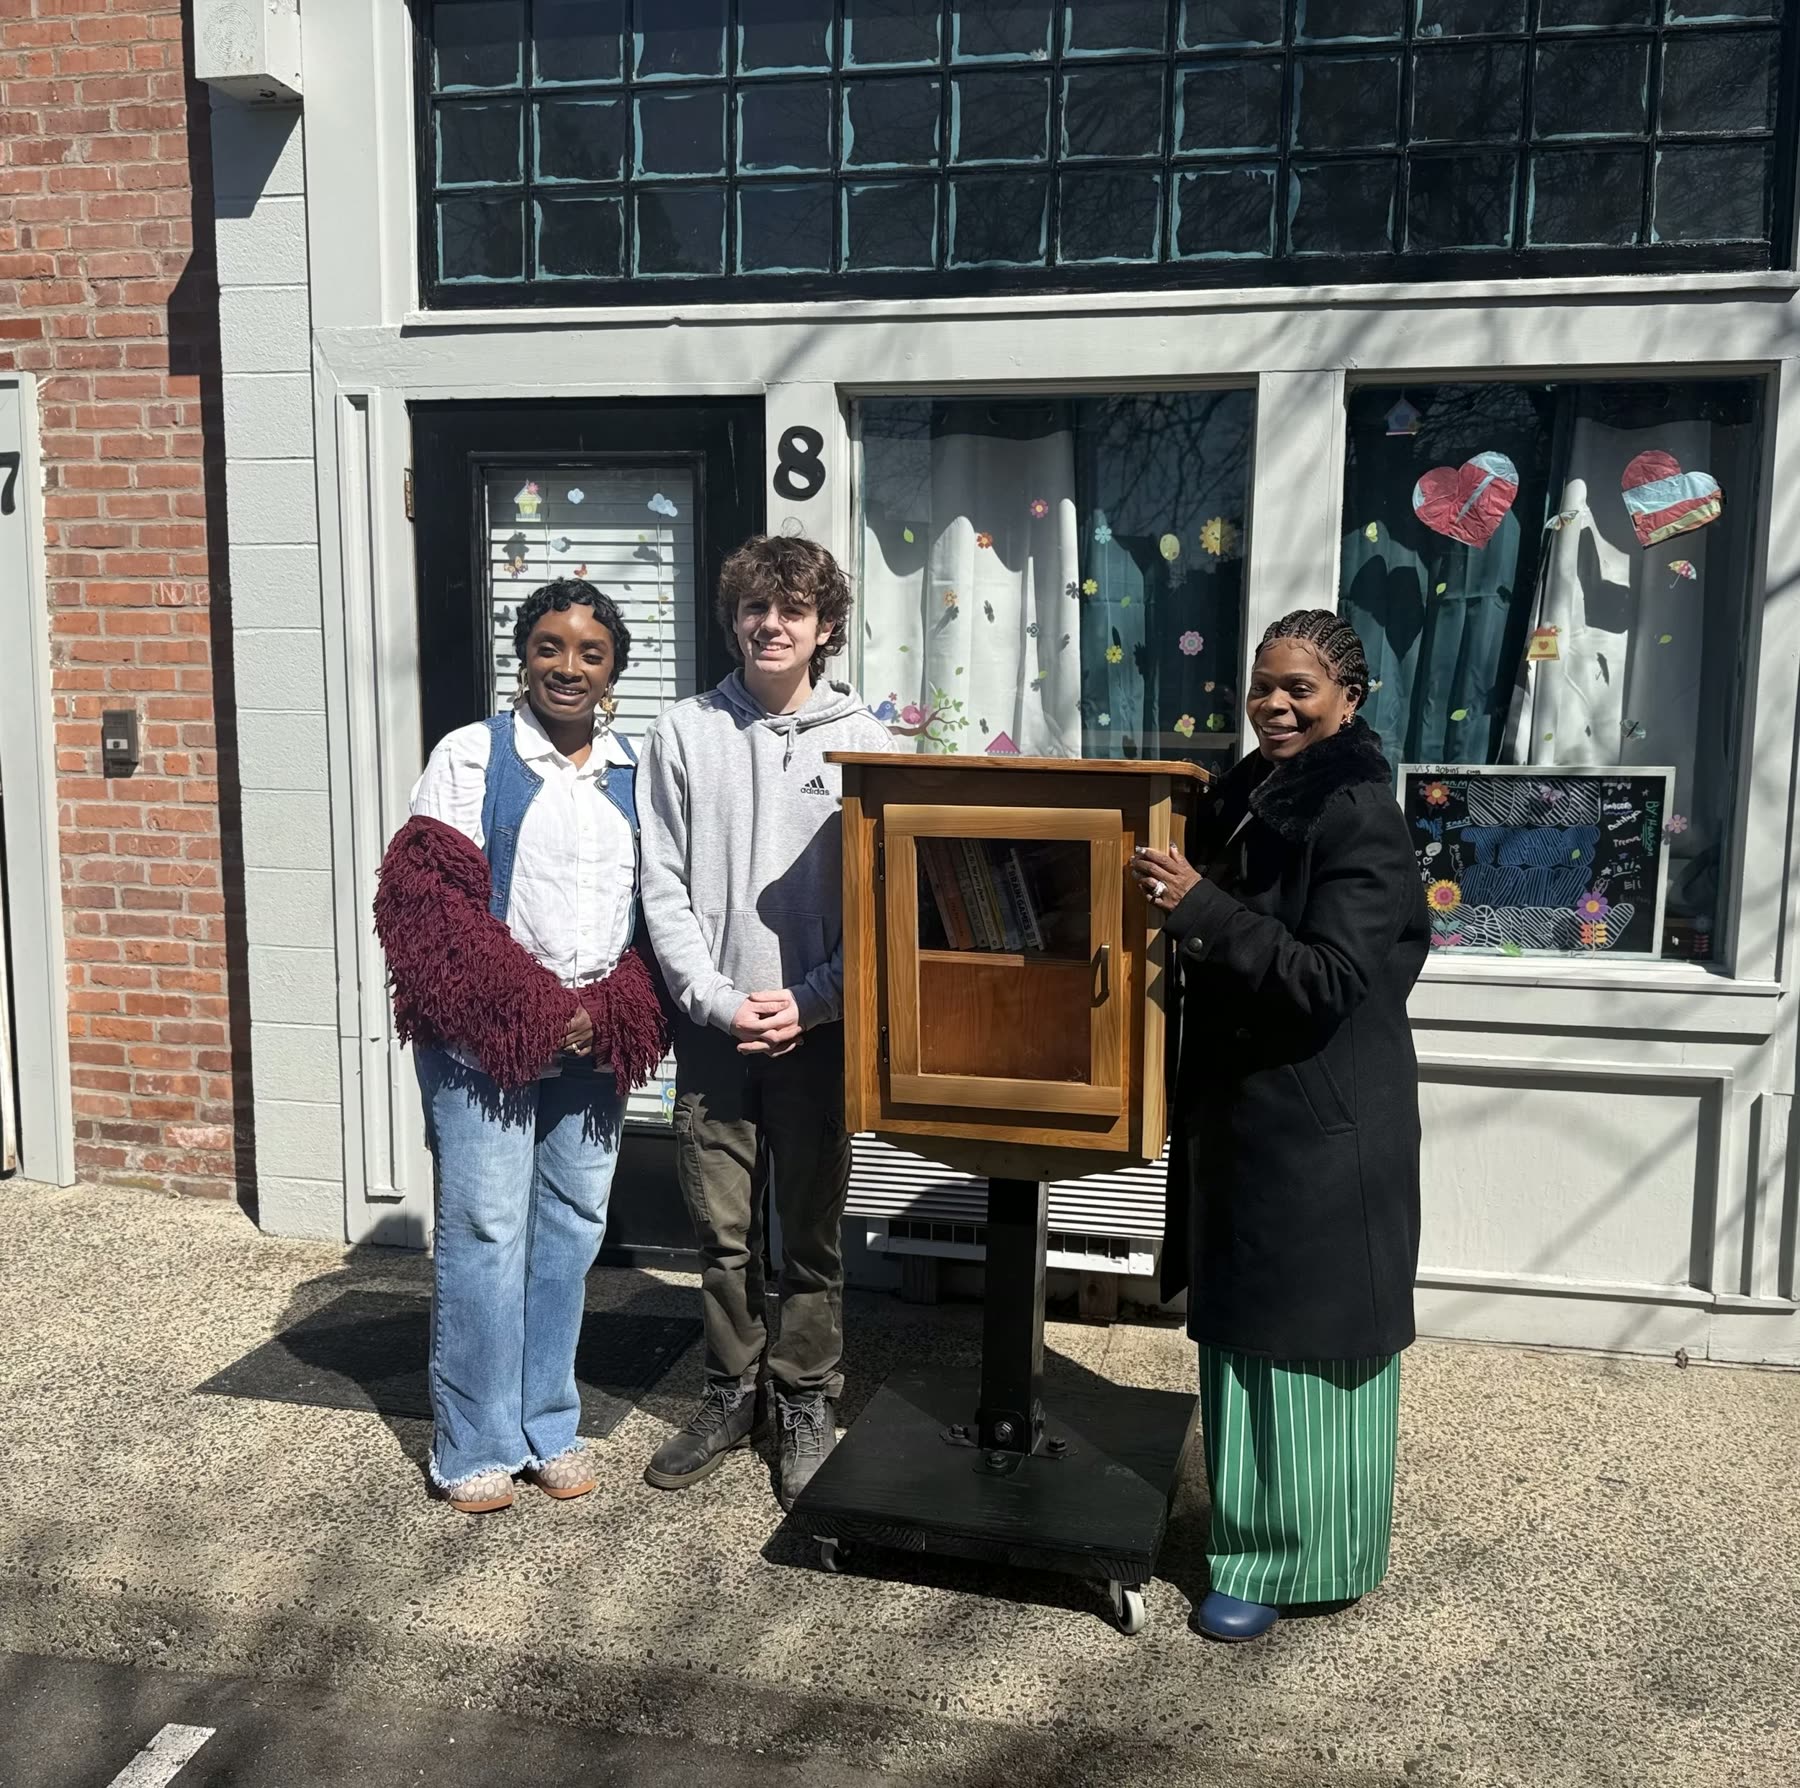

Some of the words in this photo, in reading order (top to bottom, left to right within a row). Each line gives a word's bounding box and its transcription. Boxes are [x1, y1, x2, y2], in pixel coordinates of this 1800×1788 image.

[0, 451, 21, 516] 7
[772, 425, 826, 502] 8
[800, 787, 830, 796] adidas
[1016, 897, 1032, 931] GAMES
